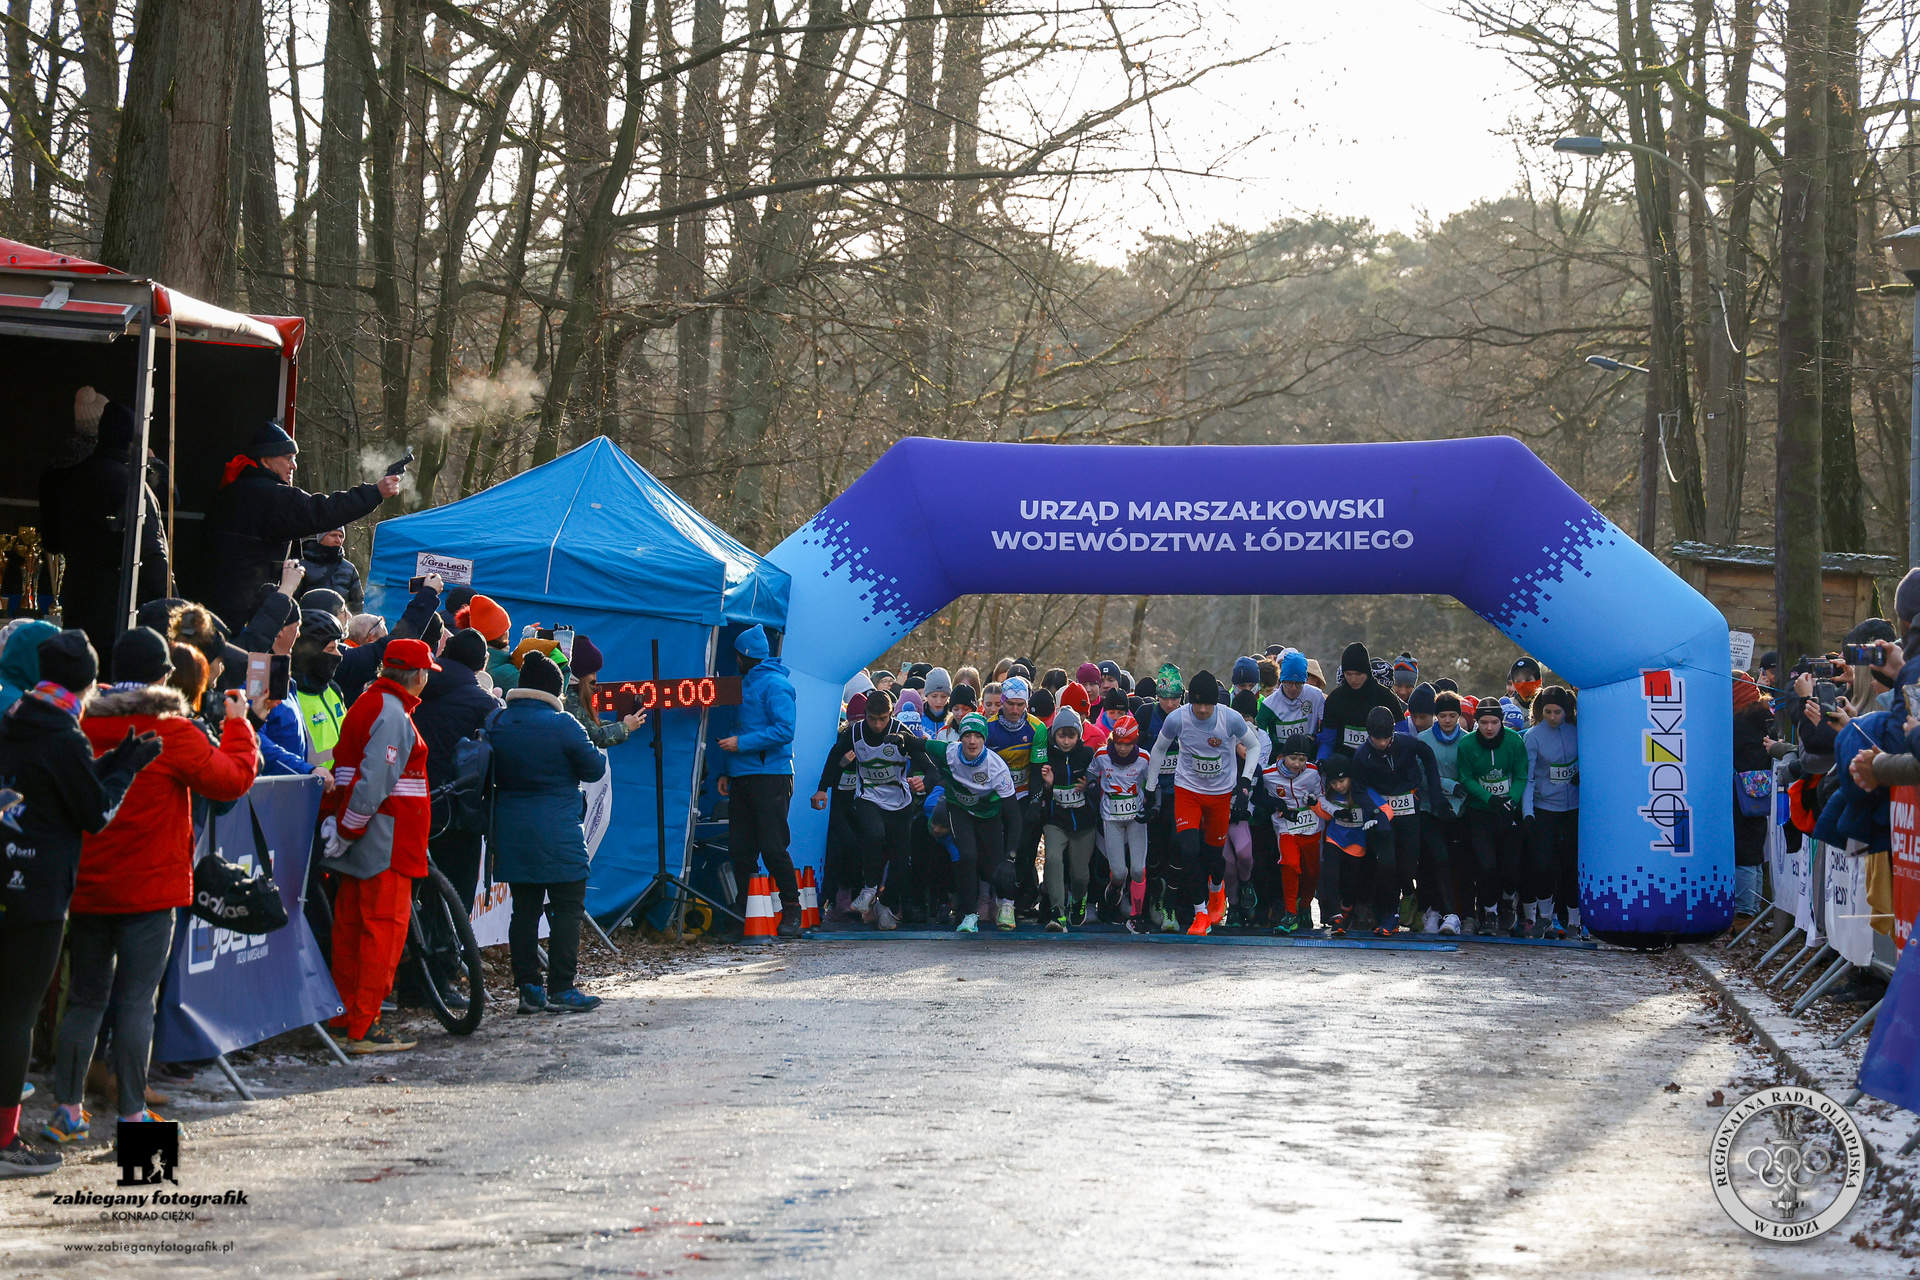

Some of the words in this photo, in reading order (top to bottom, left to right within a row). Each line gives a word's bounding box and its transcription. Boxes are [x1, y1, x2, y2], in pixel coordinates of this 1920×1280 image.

[1020, 500, 1119, 526] URZĄD
[1128, 499, 1384, 521] MARSZAŁKOWSKI
[991, 527, 1236, 552] WOJEWÓDZTWA
[1243, 528, 1413, 551] ŁÓDZKIEGO
[428, 560, 468, 571] Gra-Lech
[1282, 726, 1304, 737] 1003
[1348, 733, 1366, 743] 103
[1196, 762, 1220, 771] 1036
[1641, 680, 1690, 848] ŁÓDZKIE
[1114, 802, 1137, 812] 1106
